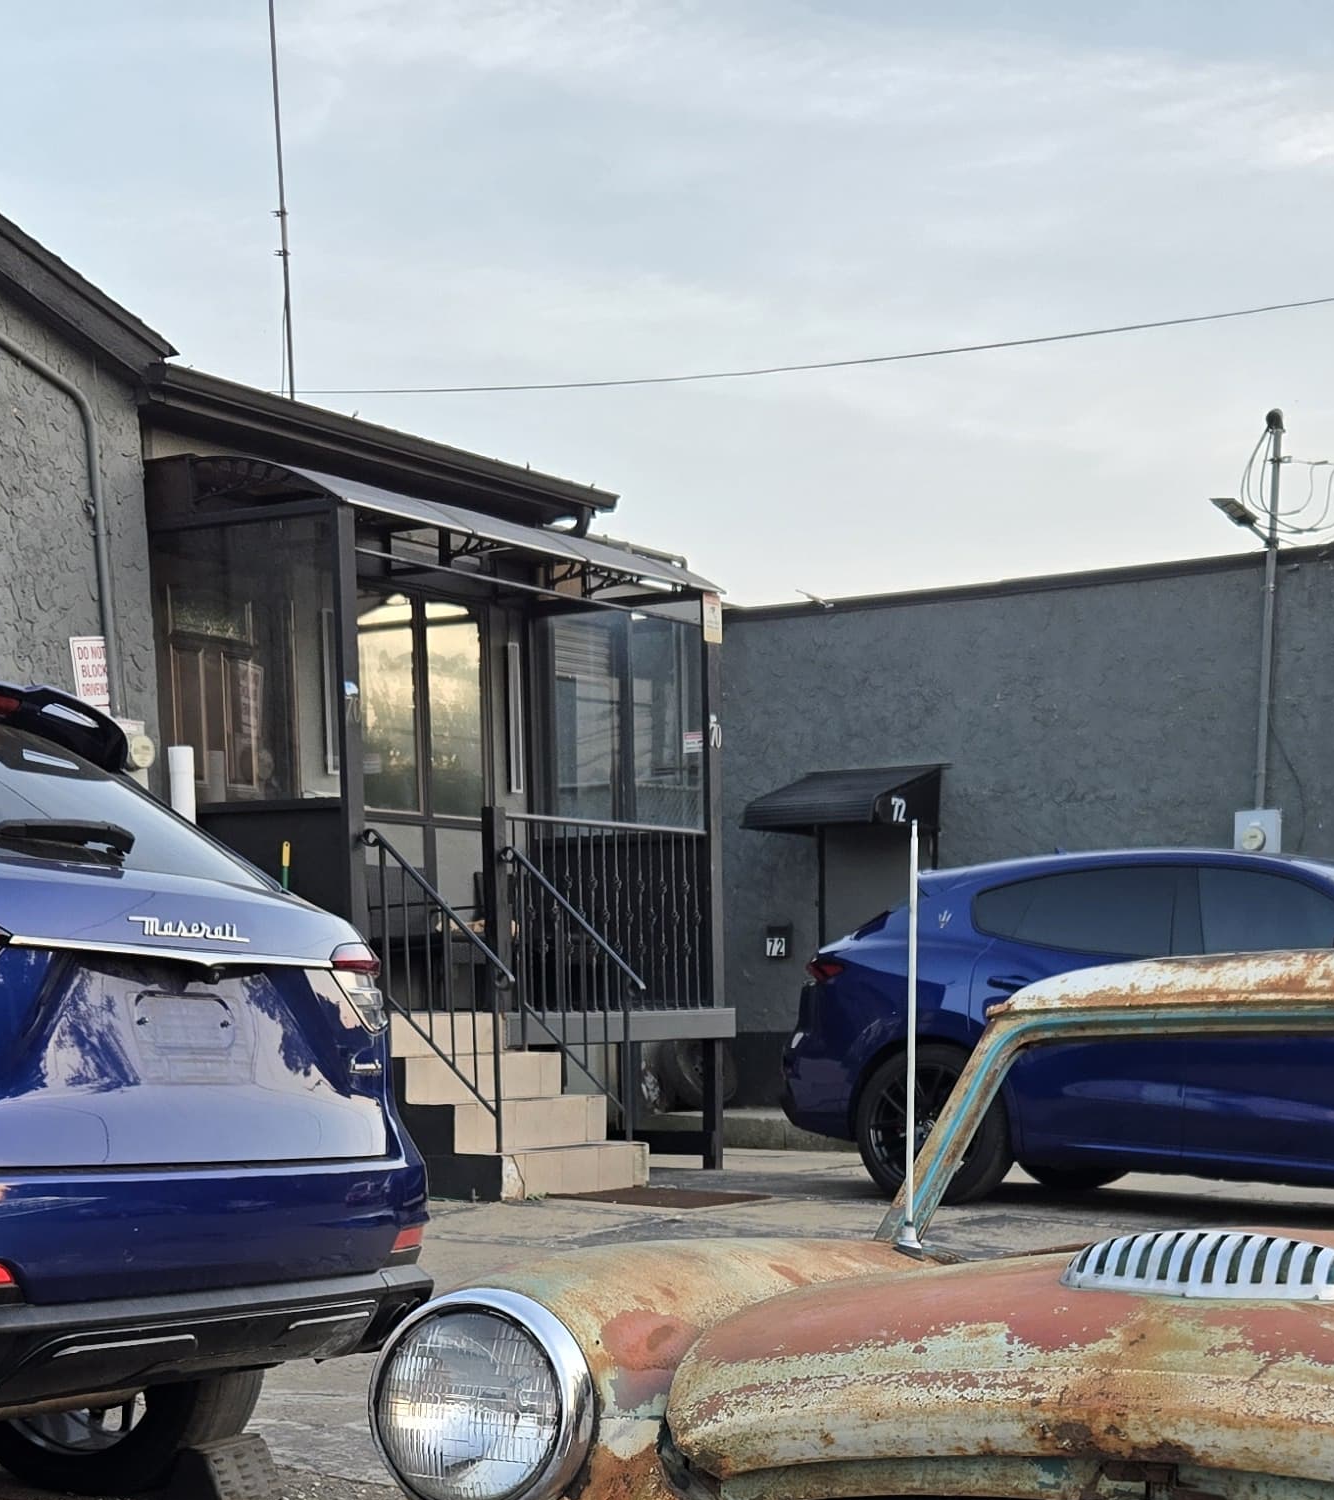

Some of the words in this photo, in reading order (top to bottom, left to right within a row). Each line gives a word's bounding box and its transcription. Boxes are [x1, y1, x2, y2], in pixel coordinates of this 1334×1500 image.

[77, 646, 89, 660] DO
[709, 723, 723, 749] 70
[891, 797, 907, 823] 72
[128, 915, 251, 943] Maserati
[767, 938, 786, 957] 72
